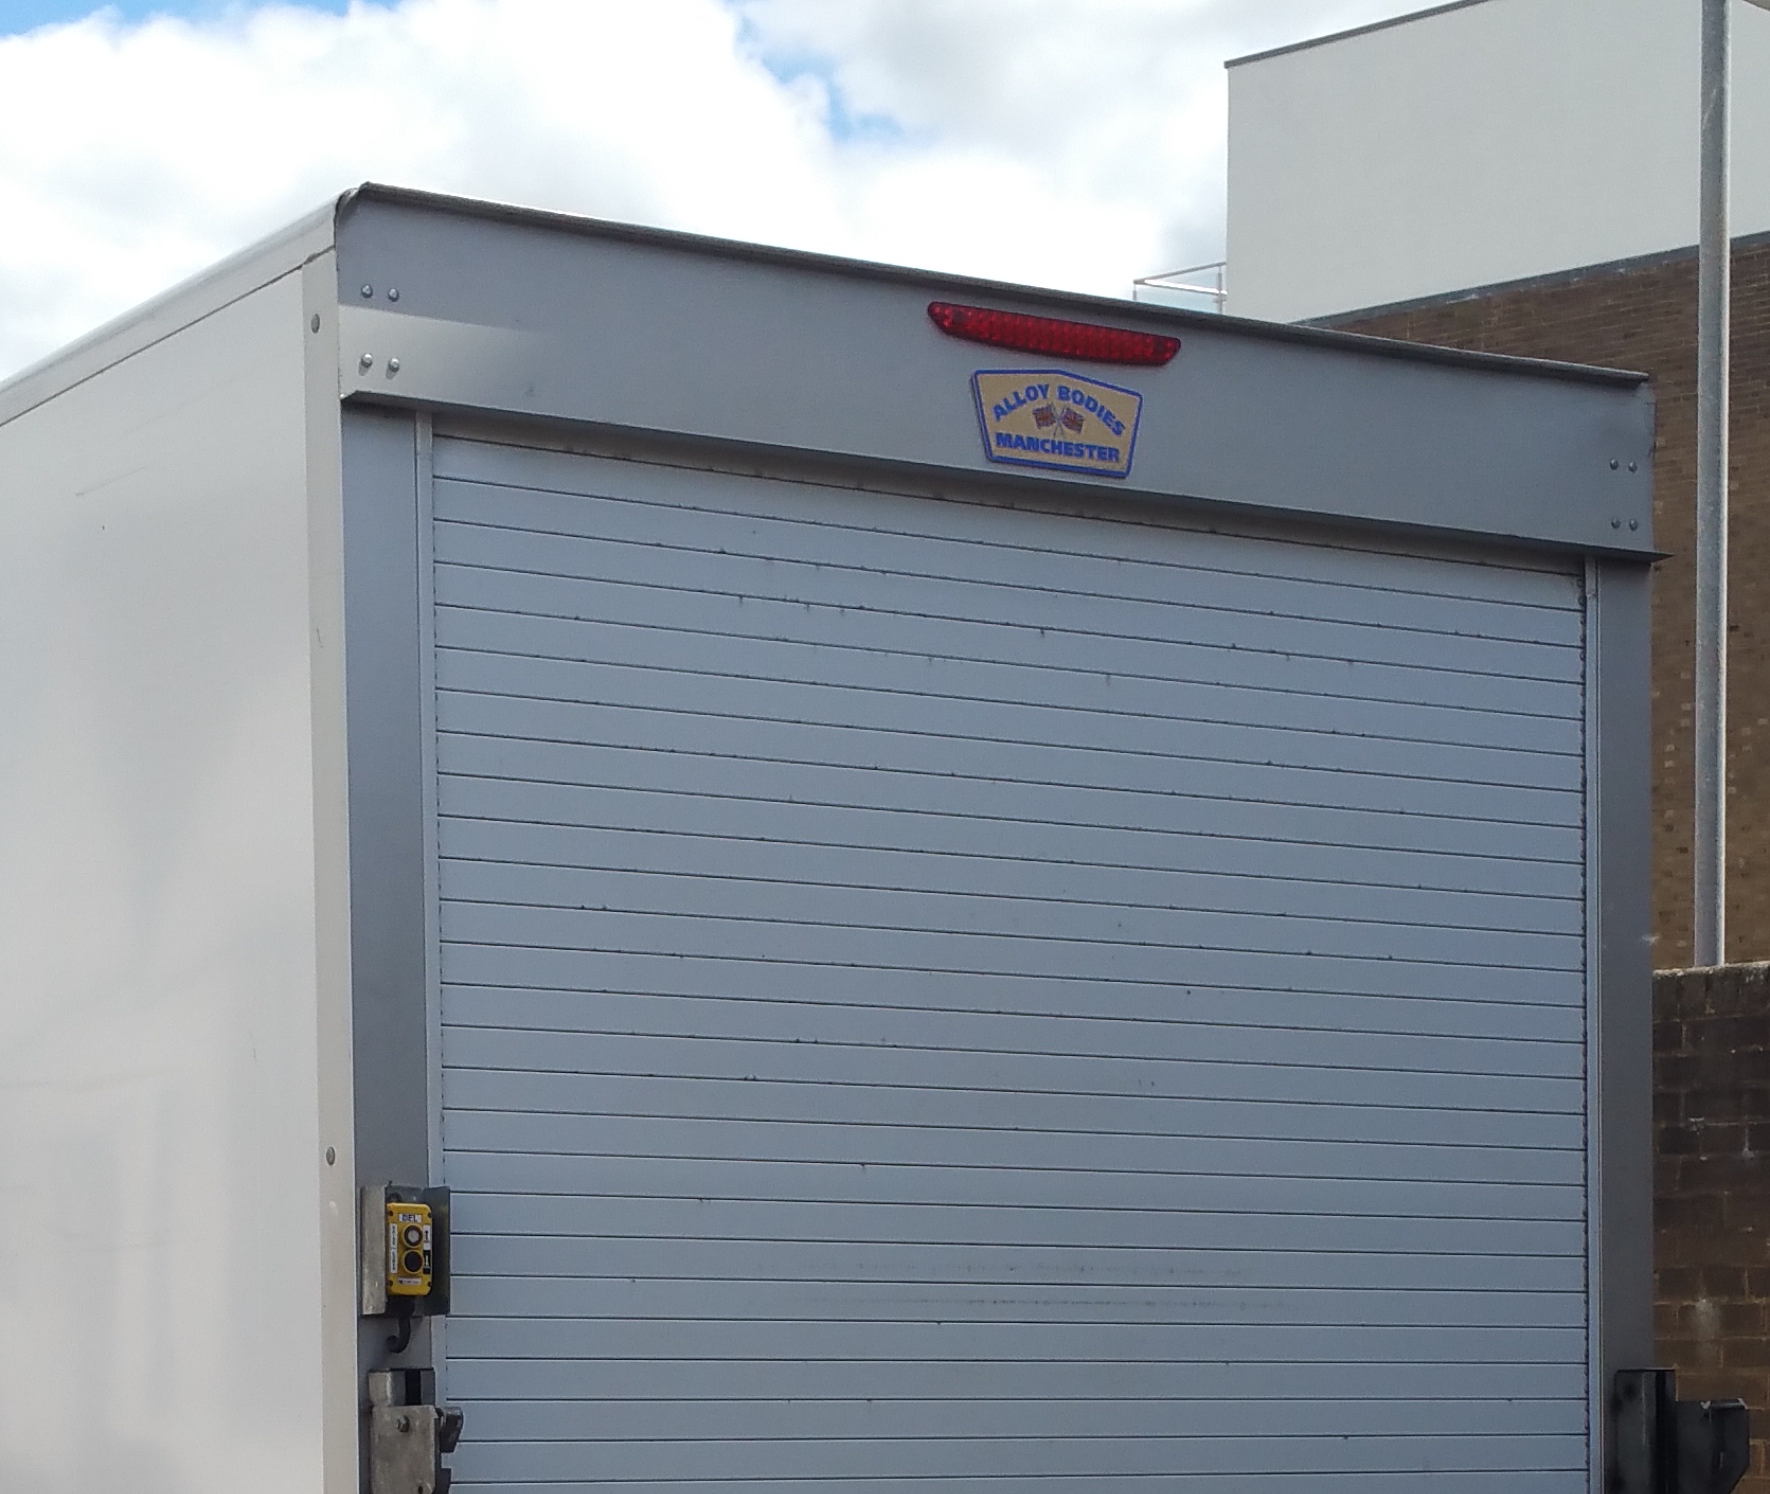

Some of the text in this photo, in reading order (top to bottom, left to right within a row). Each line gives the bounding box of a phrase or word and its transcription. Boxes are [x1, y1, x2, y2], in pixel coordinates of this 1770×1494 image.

[991, 384, 1126, 436] ALLOY BODIES
[995, 432, 1120, 462] MANCHESTER
